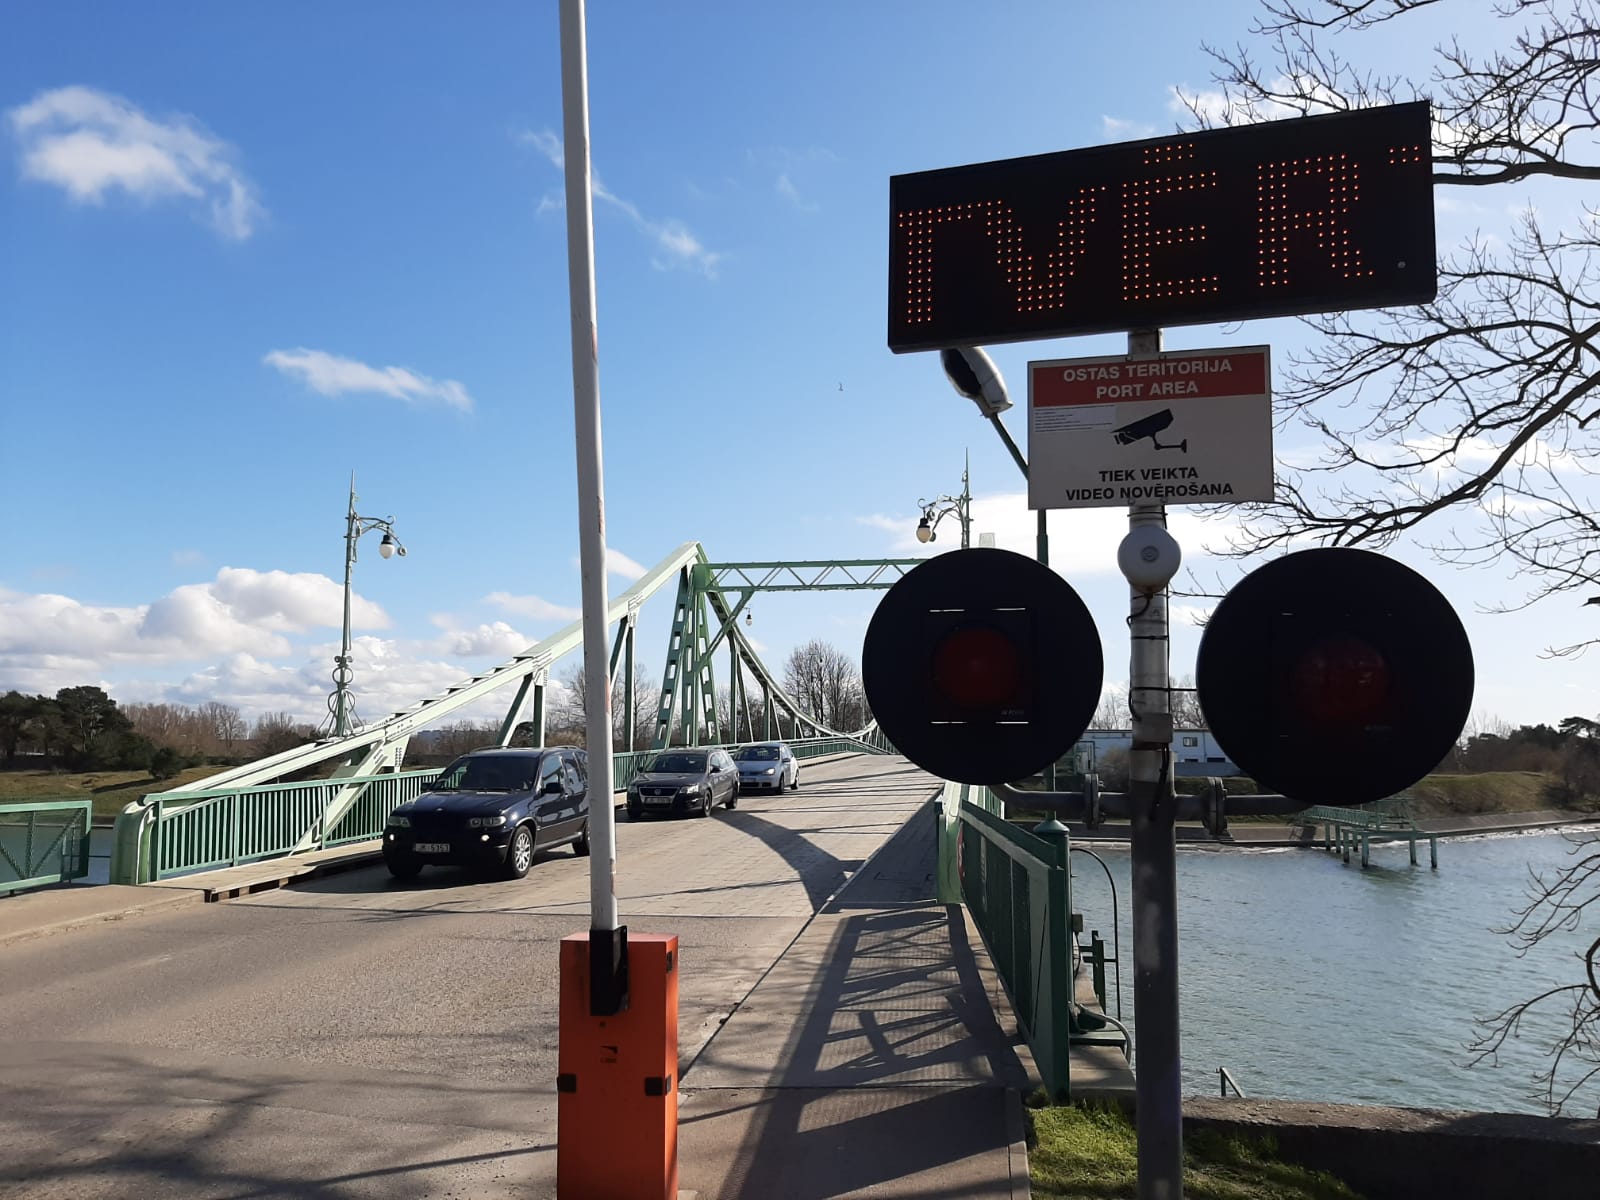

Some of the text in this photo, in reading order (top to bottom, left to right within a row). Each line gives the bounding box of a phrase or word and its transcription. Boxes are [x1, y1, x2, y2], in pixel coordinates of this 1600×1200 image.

[1063, 359, 1233, 382] OSTAS TERITORIJA
[1096, 380, 1199, 399] PORT AREA
[1099, 466, 1198, 482] TIEK VEIKTA
[1066, 482, 1233, 500] VIDEO NOVĒROŠANA
